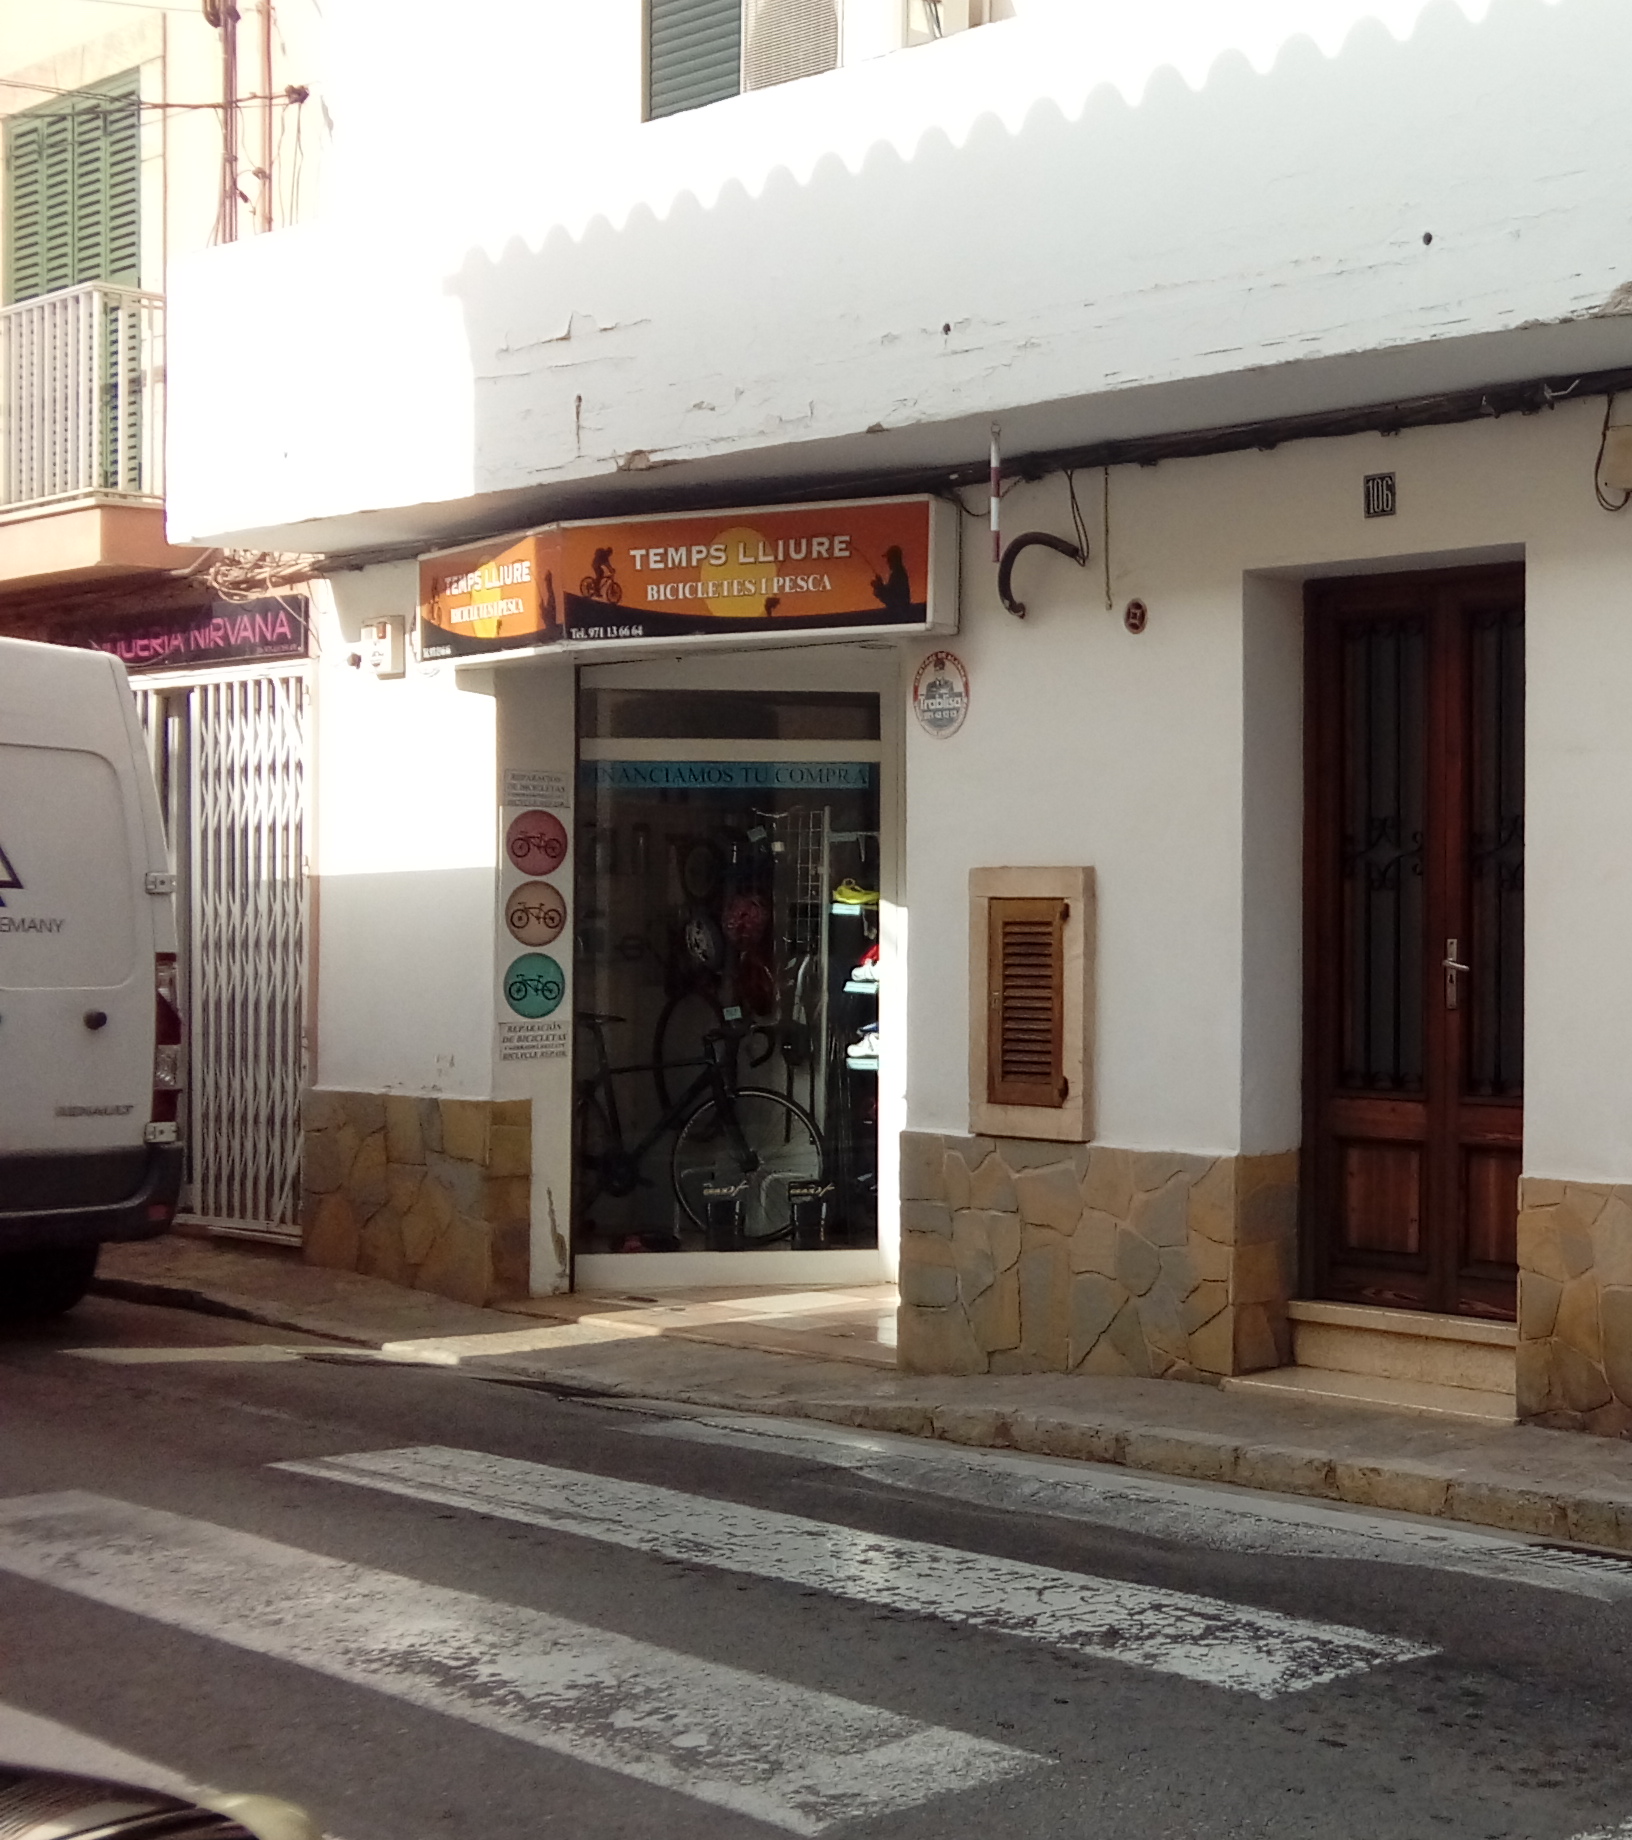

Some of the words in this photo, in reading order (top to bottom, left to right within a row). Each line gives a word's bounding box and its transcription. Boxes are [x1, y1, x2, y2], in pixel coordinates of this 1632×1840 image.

[1366, 477, 1392, 513] 106
[630, 544, 727, 570] TEMPS
[738, 535, 851, 564] LLIURE
[445, 570, 482, 595] TEMPS
[484, 561, 531, 588] LLIURE
[647, 579, 756, 601] BICICLETES
[761, 577, 768, 594] I
[773, 574, 832, 593] PESCA
[190, 610, 292, 650] NIRVANA
[570, 627, 587, 638] Tel.
[588, 626, 604, 638] 971
[607, 626, 617, 637] 13
[741, 767, 767, 784] TU
[775, 768, 869, 785] COMPRA
